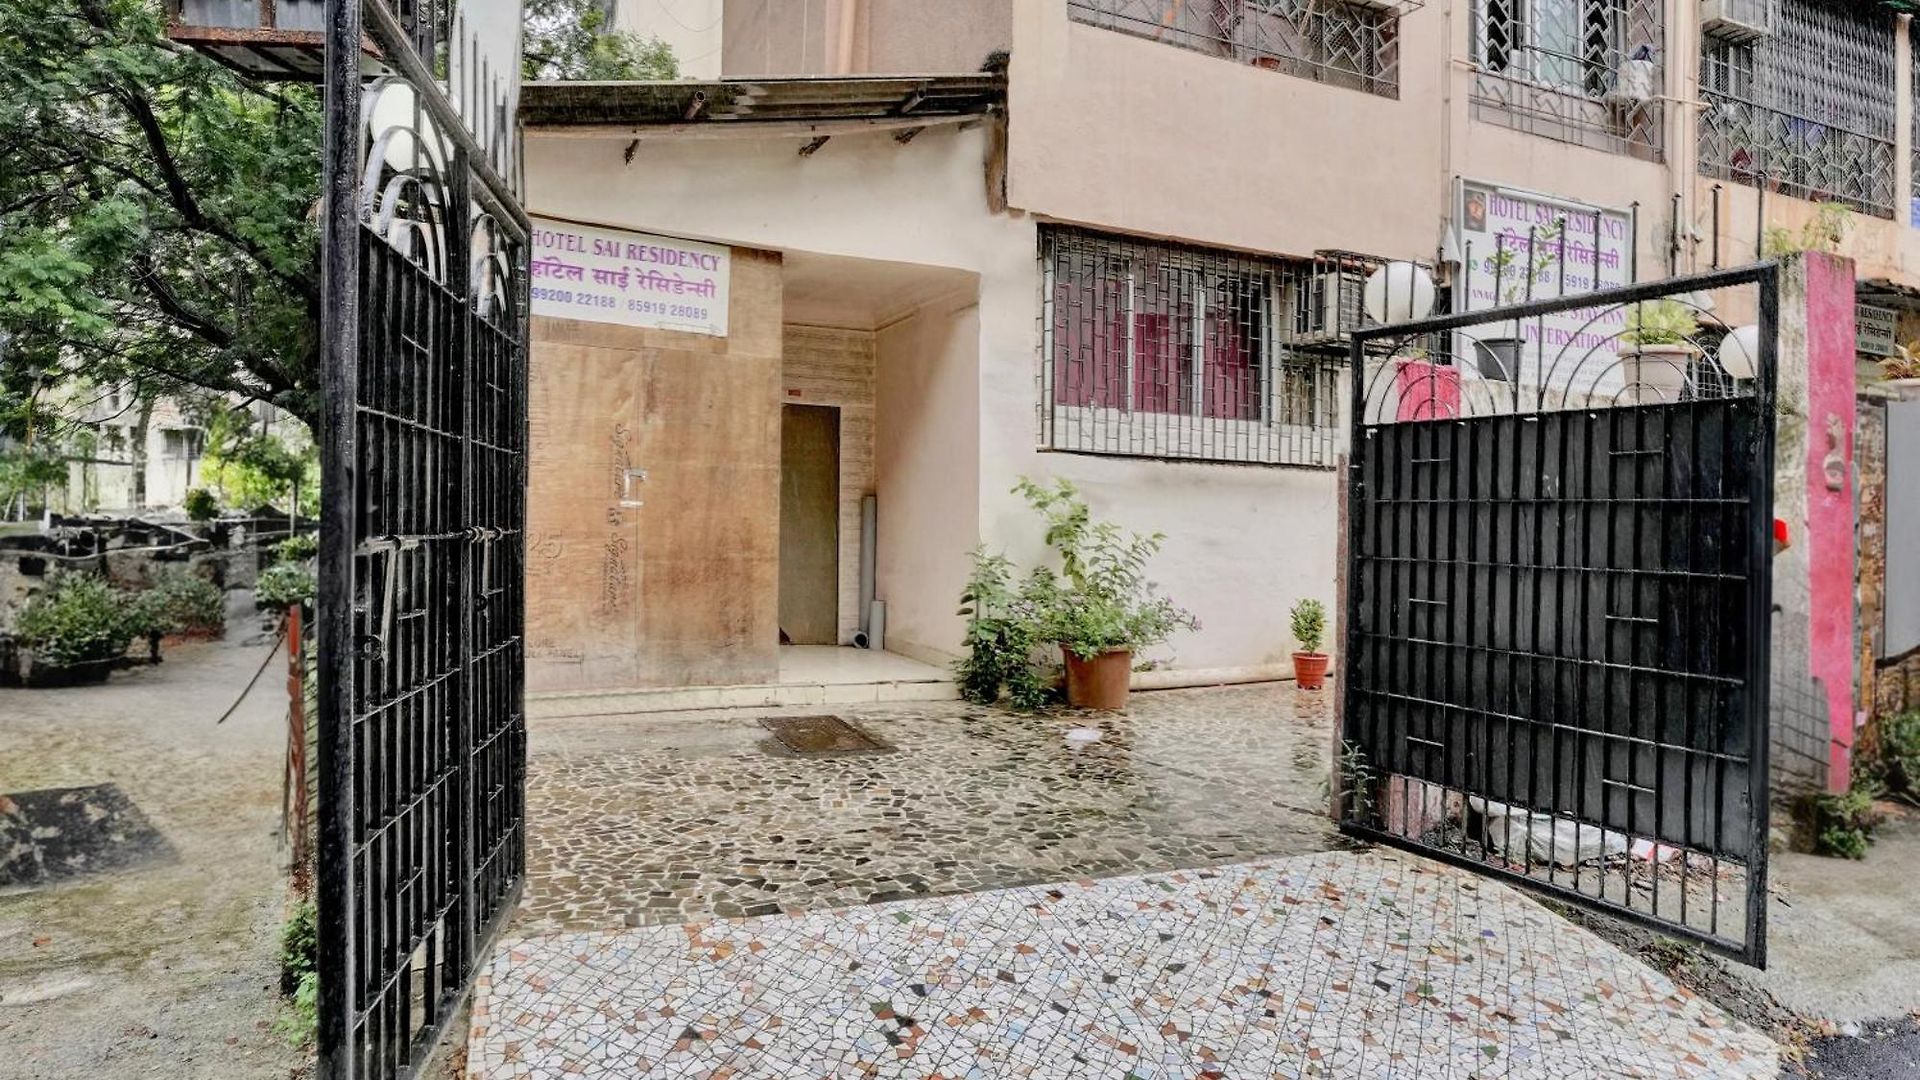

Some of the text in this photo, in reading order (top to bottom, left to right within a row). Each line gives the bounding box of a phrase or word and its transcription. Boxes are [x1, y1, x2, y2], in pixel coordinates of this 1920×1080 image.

[1488, 192, 1531, 222] HOTEL
[1560, 209, 1625, 241] ESIDNCY
[531, 229, 721, 272] HOTEL SAI RESIDENCY
[592, 266, 630, 292] साई
[635, 267, 717, 299] रेसिडेन्सी
[1560, 272, 1590, 291] 5919
[531, 287, 709, 321] 99200 22188 85919 28089
